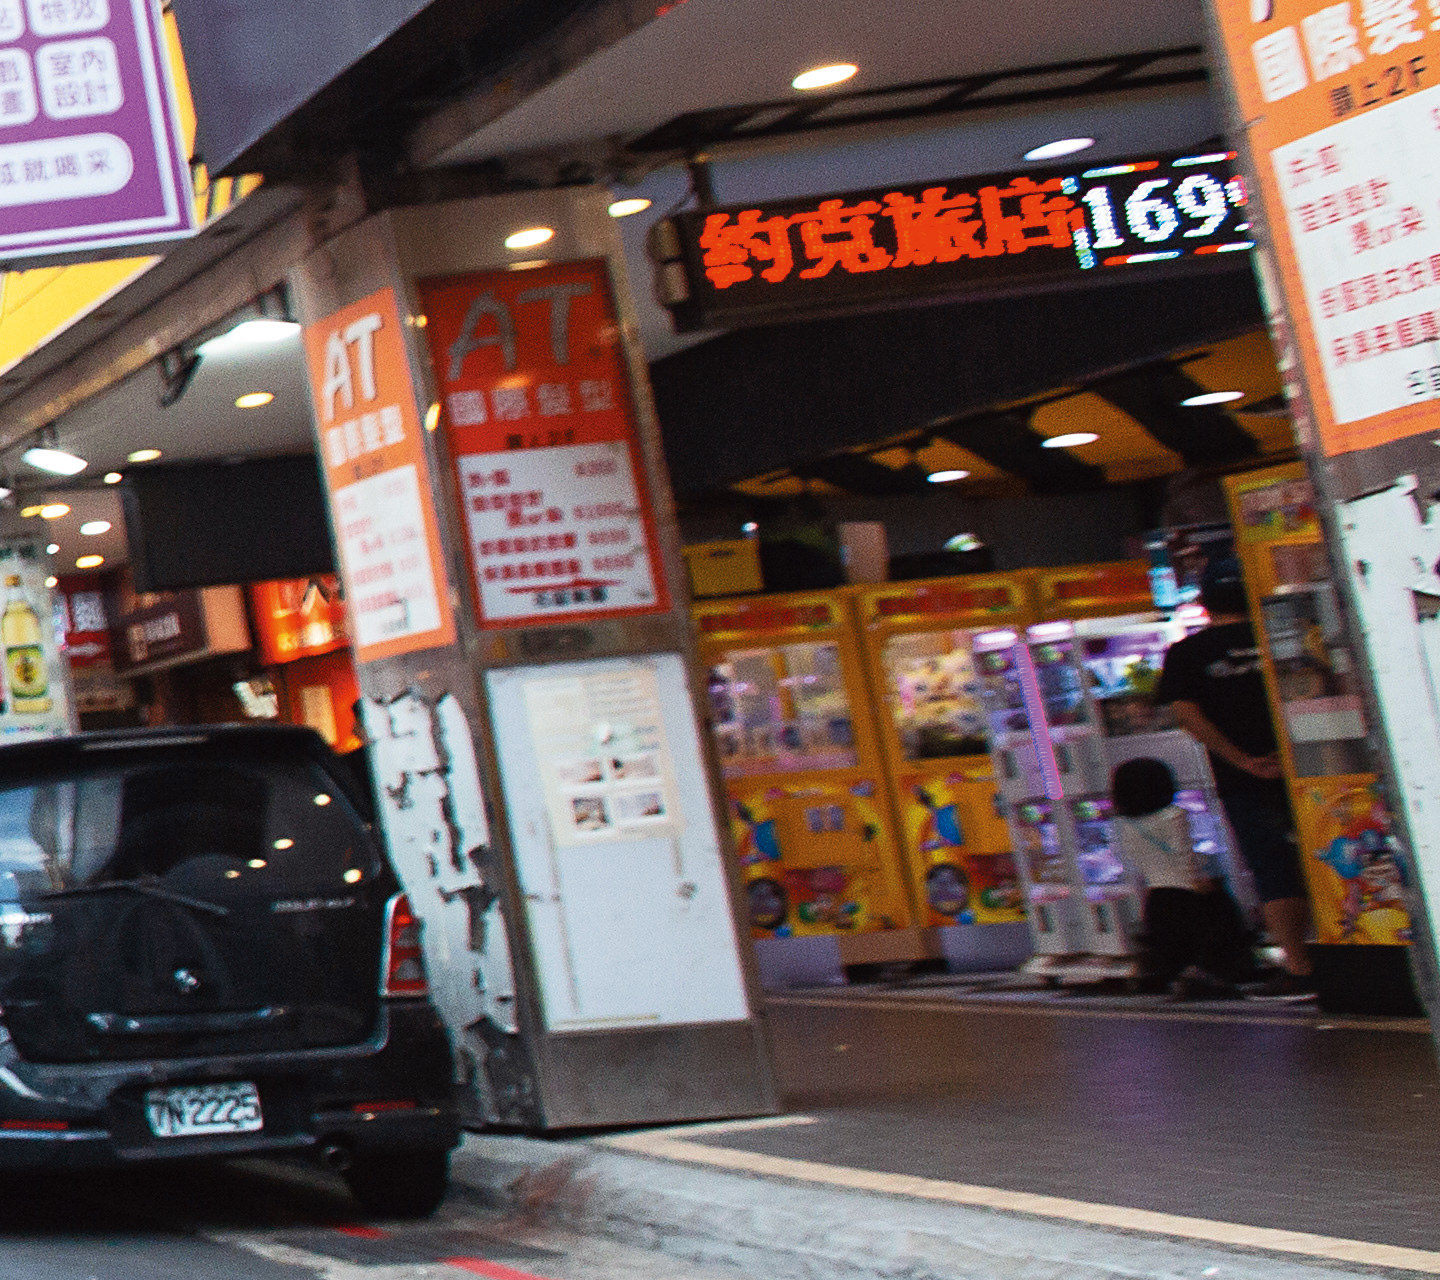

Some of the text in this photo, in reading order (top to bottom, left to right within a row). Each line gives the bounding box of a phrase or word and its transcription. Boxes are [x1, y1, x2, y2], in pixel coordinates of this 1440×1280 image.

[700, 178, 1079, 290] 約克旅店
[323, 312, 382, 421] AT
[447, 282, 592, 383] AT
